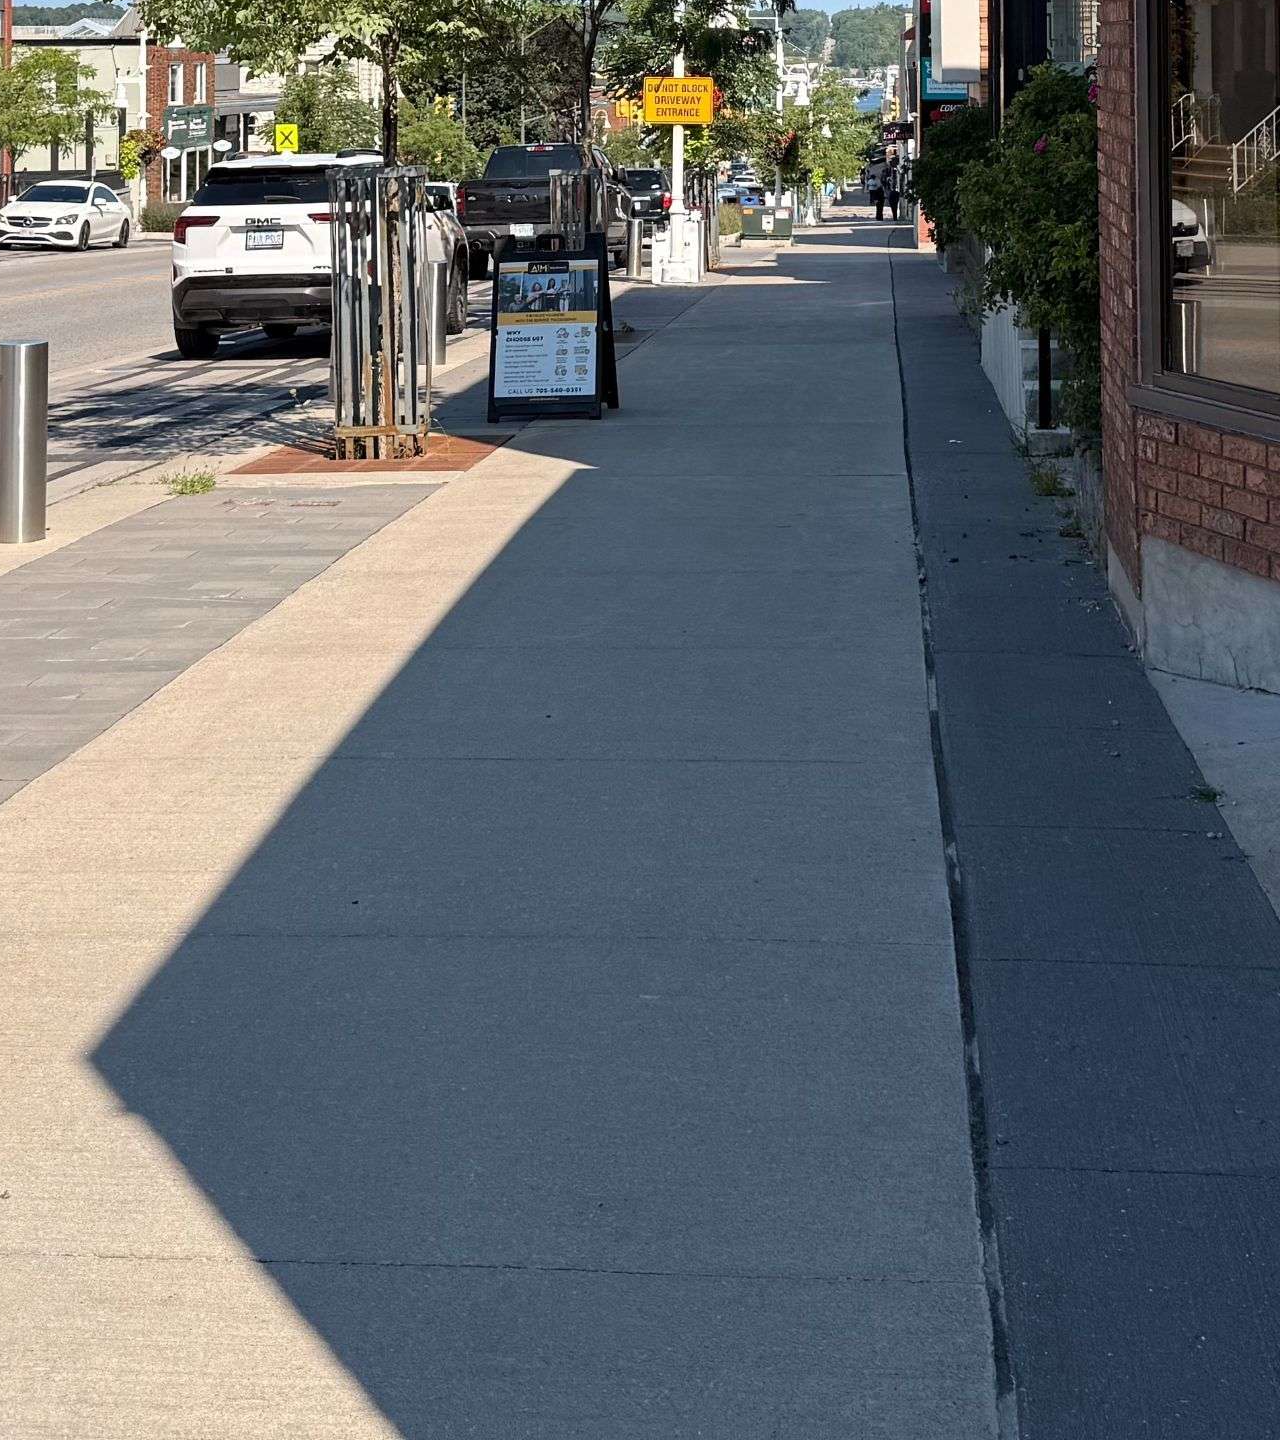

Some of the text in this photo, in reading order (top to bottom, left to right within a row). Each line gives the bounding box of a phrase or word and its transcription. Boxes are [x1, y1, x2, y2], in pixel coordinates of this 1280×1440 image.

[647, 83, 709, 93] DO NOT BLOCK
[654, 95, 702, 105] DRIVEWAY
[656, 107, 701, 117] ENTRANCE
[245, 217, 281, 225] GMC
